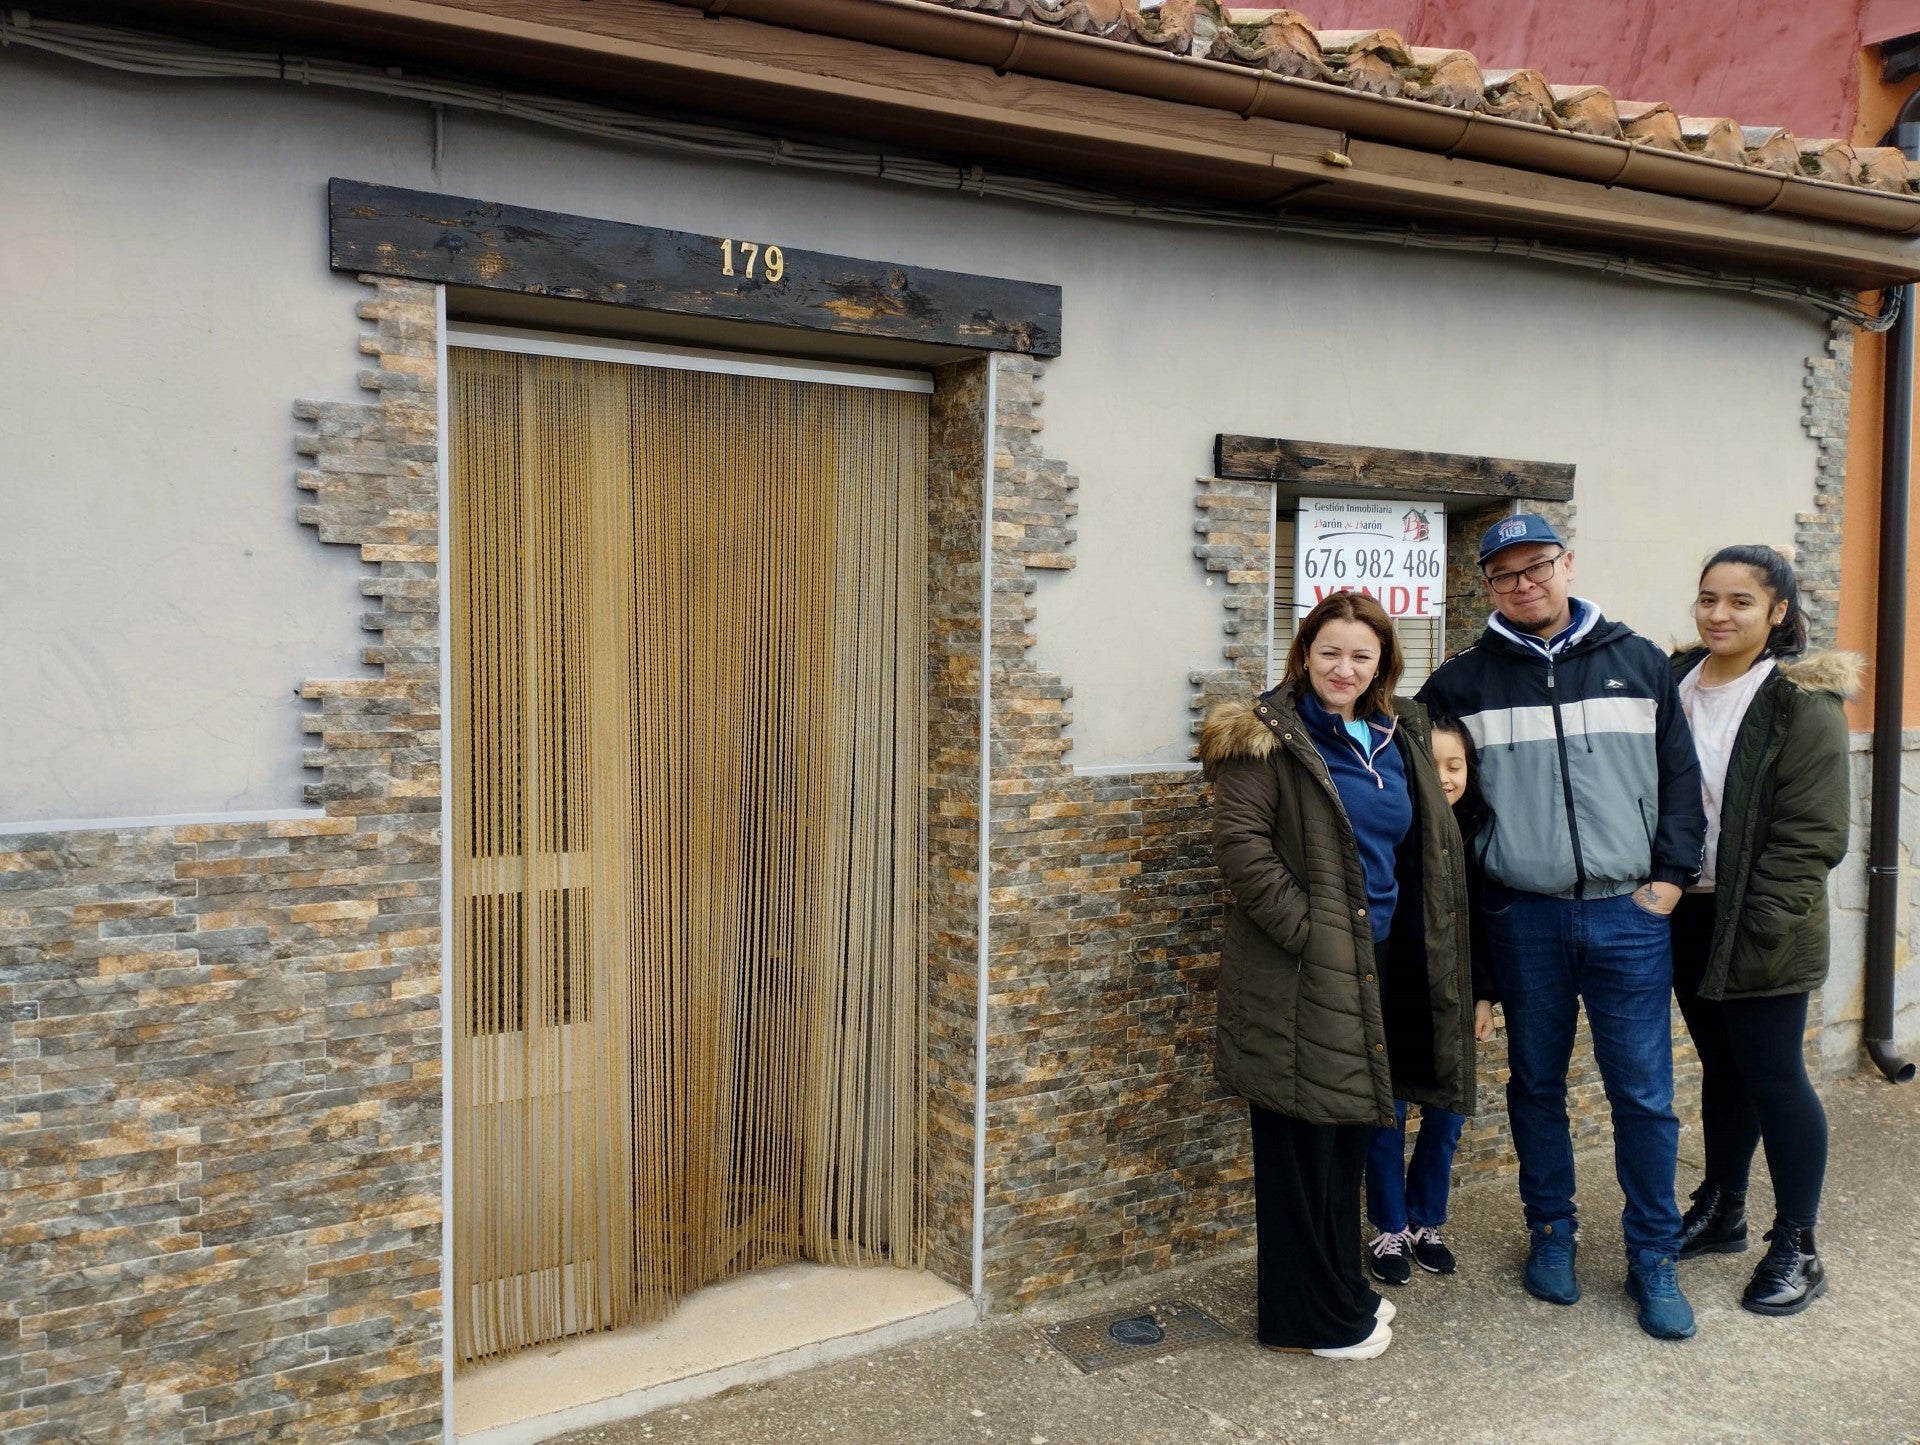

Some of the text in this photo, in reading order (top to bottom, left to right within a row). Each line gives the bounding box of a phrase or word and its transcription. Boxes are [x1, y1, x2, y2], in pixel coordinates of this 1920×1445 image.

[720, 238, 784, 282] 179
[1314, 502, 1393, 514] Gestión Inmobiliaria
[1313, 518, 1342, 529] Barón
[1354, 519, 1382, 530] Barón
[1305, 548, 1440, 579] 676 982 486
[1313, 585, 1430, 616] VNDE
